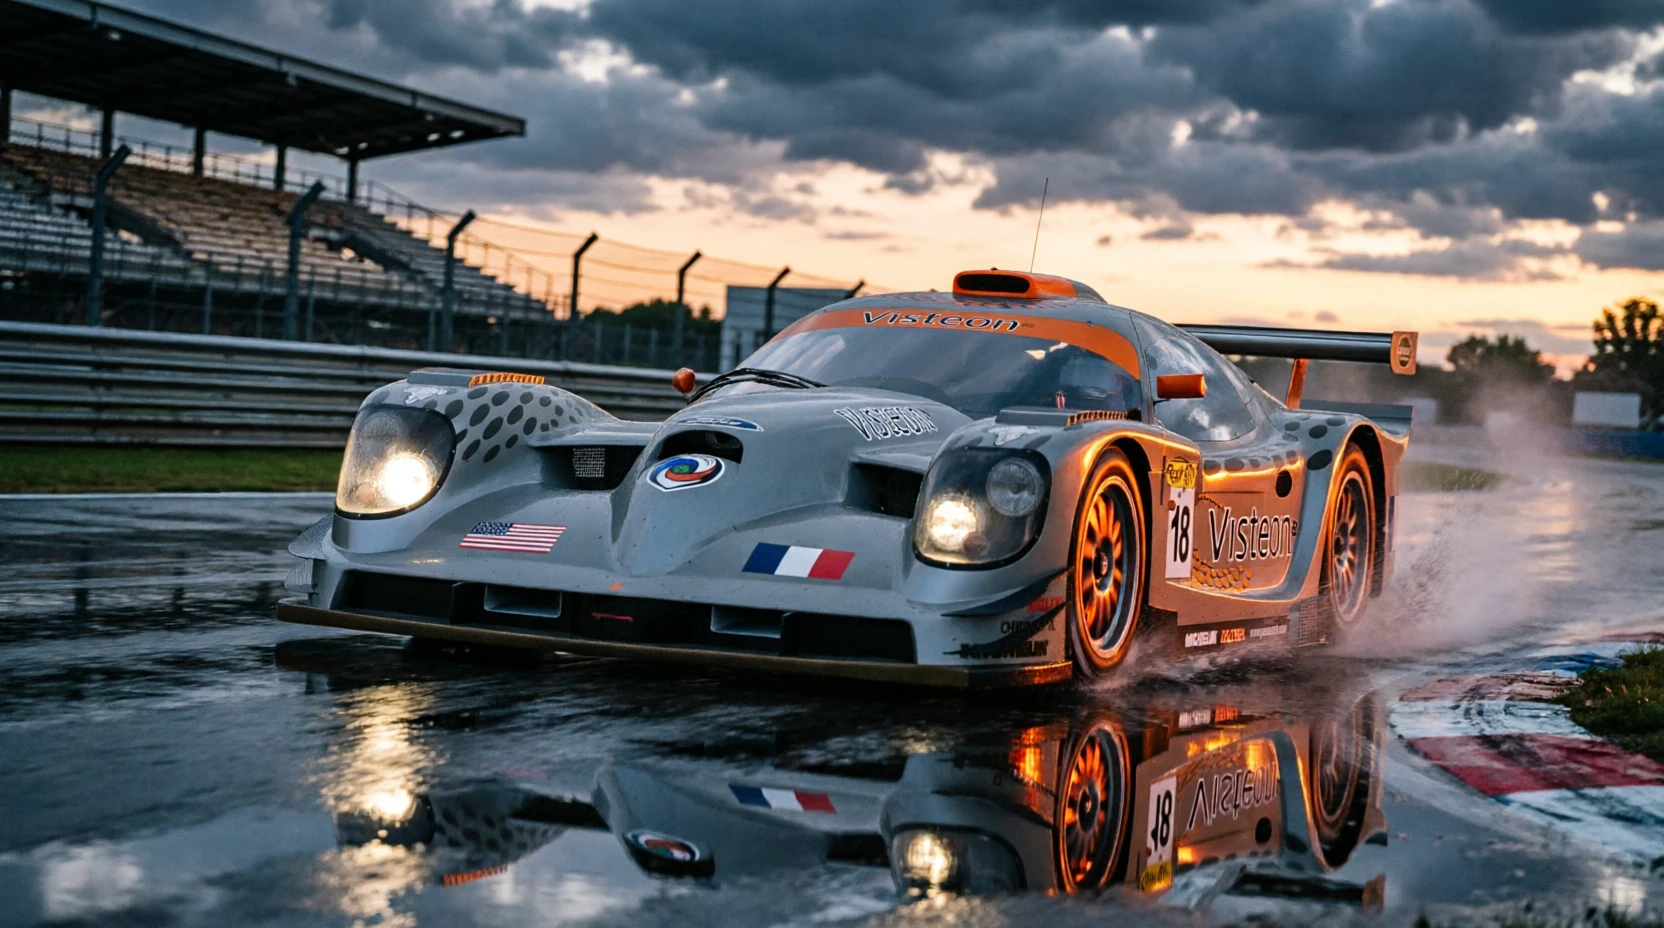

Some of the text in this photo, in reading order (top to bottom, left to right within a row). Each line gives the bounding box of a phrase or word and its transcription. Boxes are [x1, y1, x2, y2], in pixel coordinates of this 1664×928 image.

[863, 311, 1021, 332] Visteon
[1171, 505, 1191, 563] 18
[1208, 506, 1292, 563] Visteon
